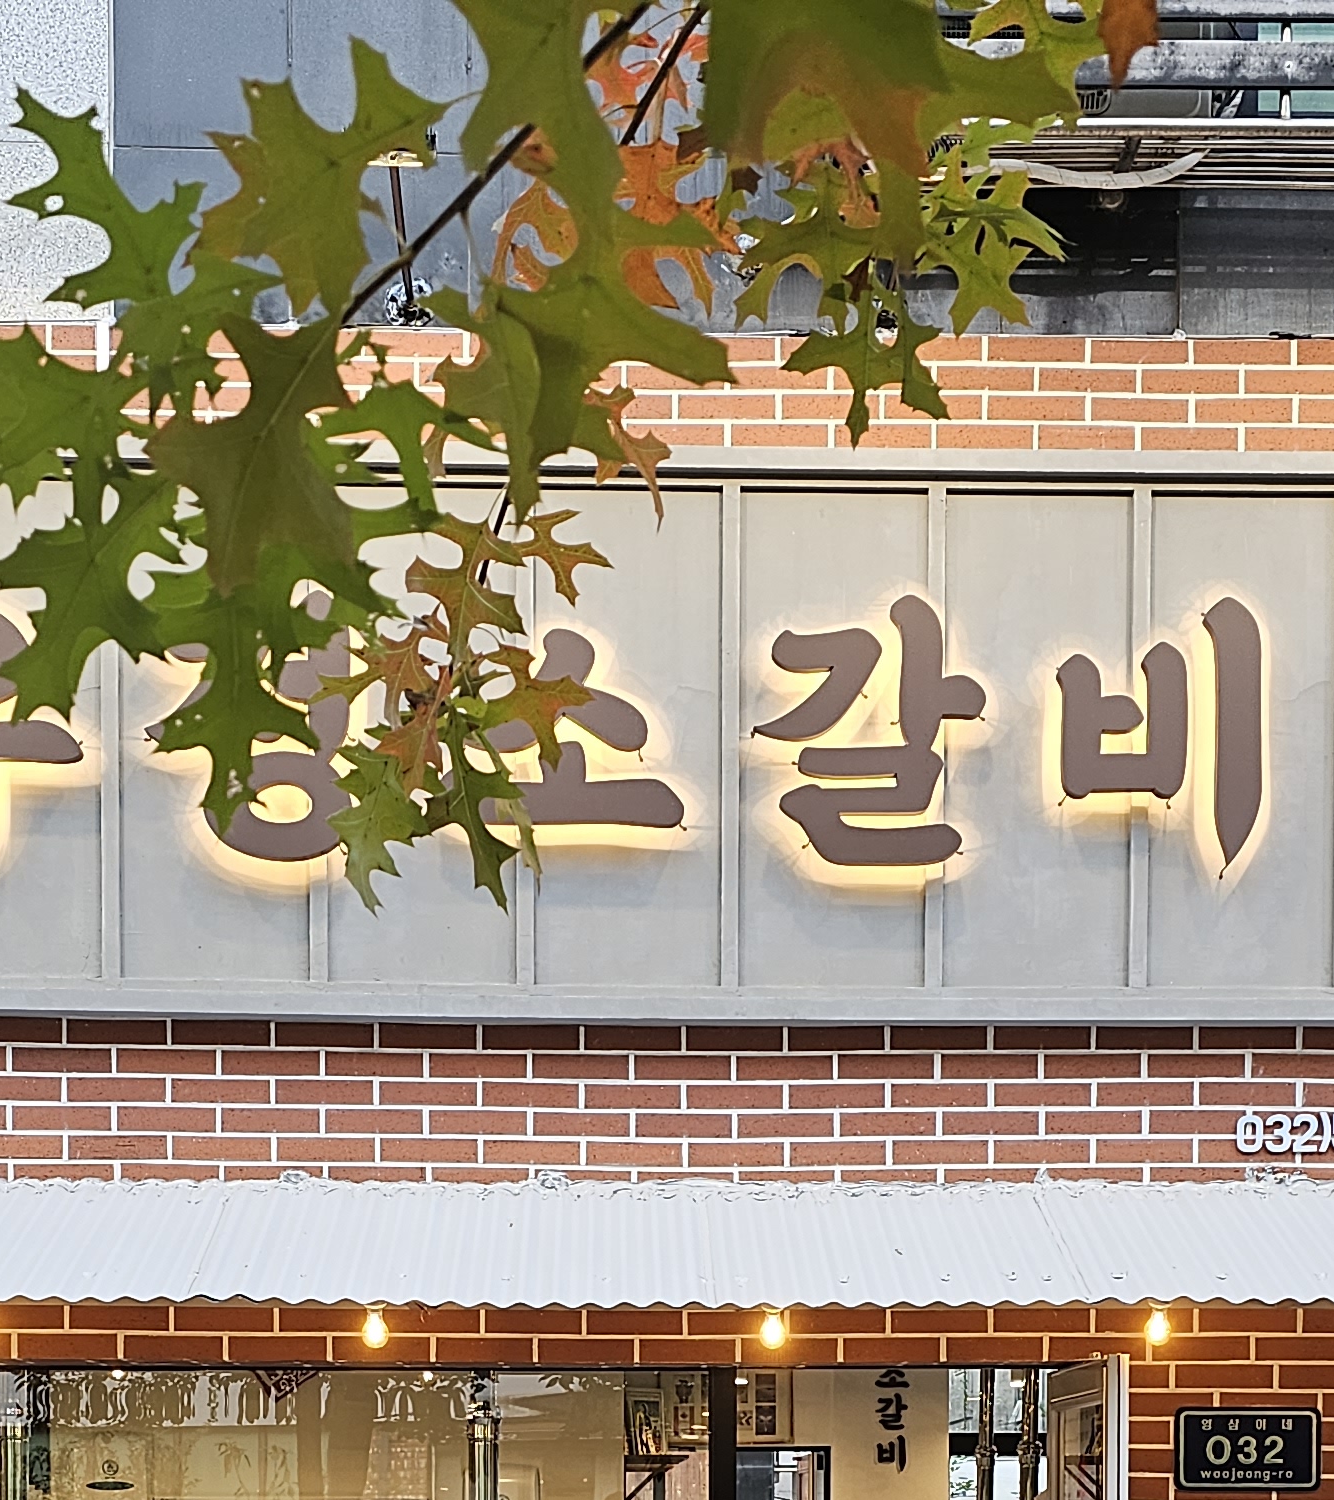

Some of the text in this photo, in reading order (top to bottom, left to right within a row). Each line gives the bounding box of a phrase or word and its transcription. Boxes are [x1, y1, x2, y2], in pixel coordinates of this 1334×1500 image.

[874, 1369, 910, 1473] 소갈비
[1205, 1435, 1284, 1465] 032
[1199, 1467, 1294, 1482] woojeong-ro
